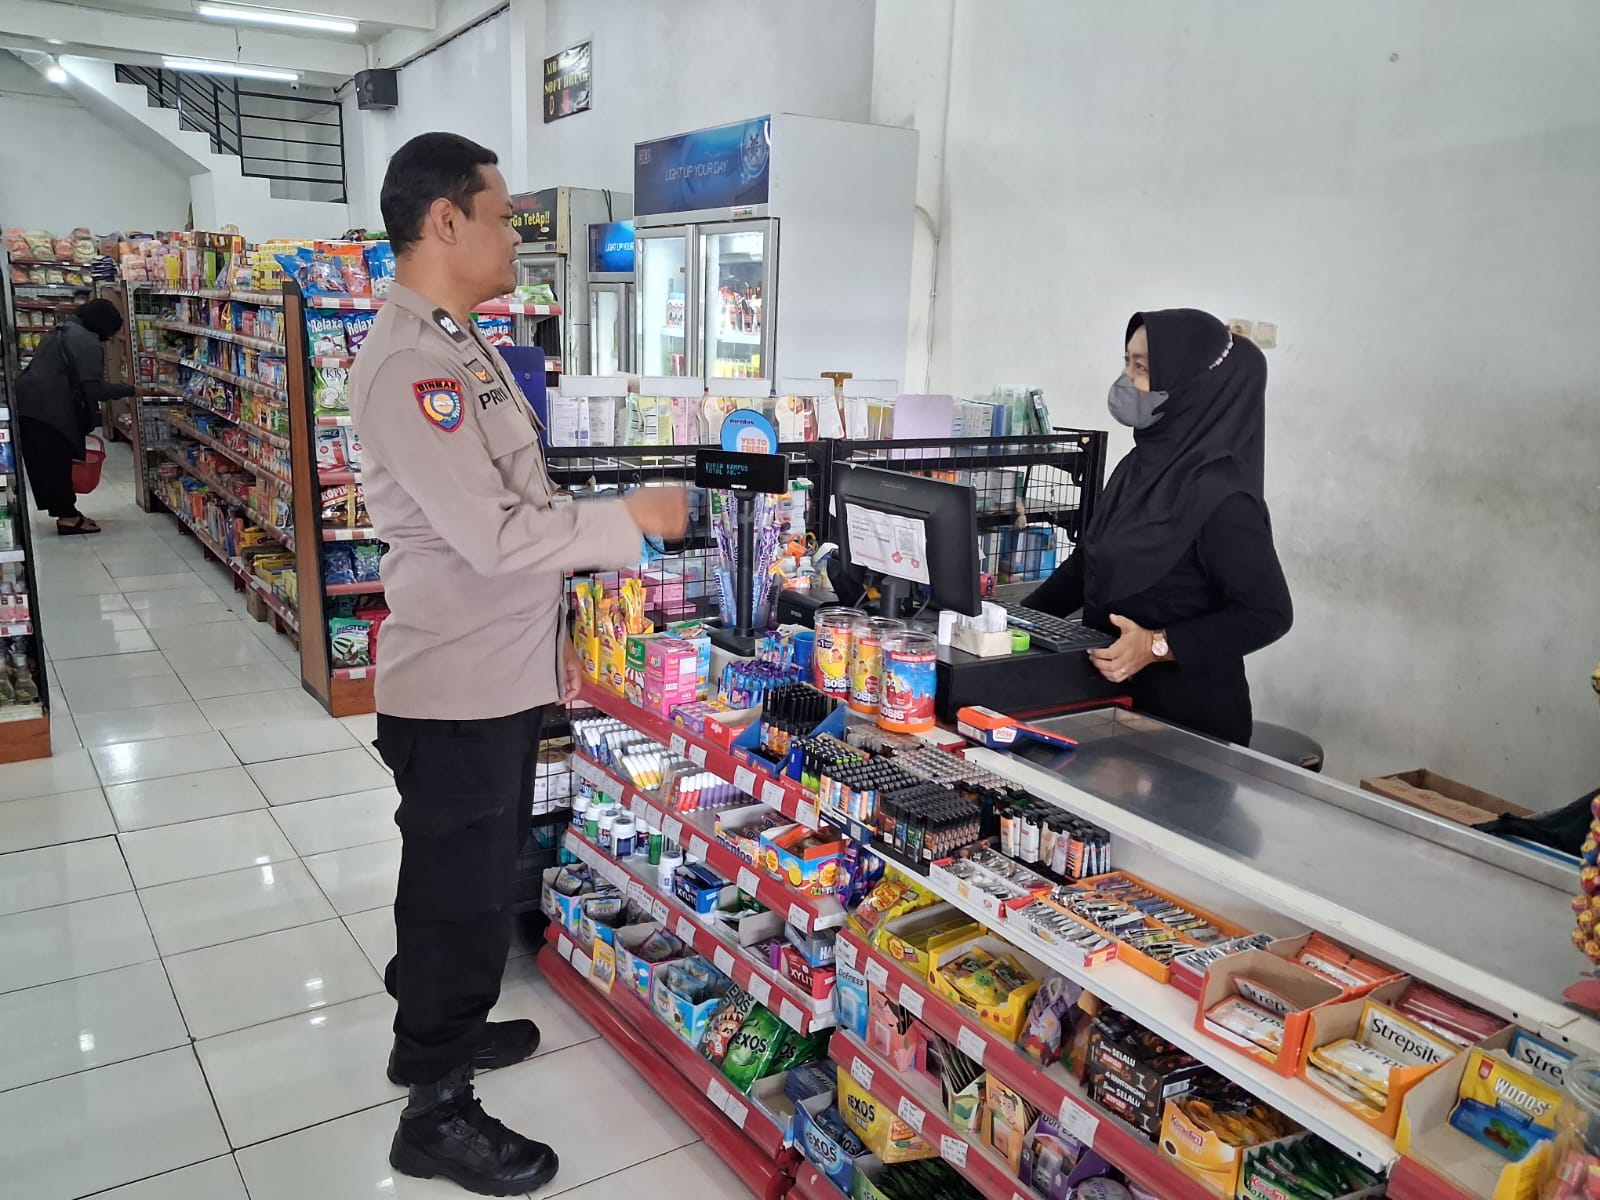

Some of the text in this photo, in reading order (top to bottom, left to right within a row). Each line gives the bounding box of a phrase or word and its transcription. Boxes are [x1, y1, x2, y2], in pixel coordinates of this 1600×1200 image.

[545, 78, 561, 94] SOFT
[665, 159, 729, 181] LIGHT UP YOUR DAY
[311, 318, 344, 333] Relaxa
[757, 438, 768, 446] TO
[321, 484, 348, 502] KOPIK
[715, 832, 753, 865] mentos
[1370, 1017, 1442, 1066] Strepsils
[1111, 1048, 1136, 1068] SELALU
[1115, 1088, 1140, 1108] SELALU
